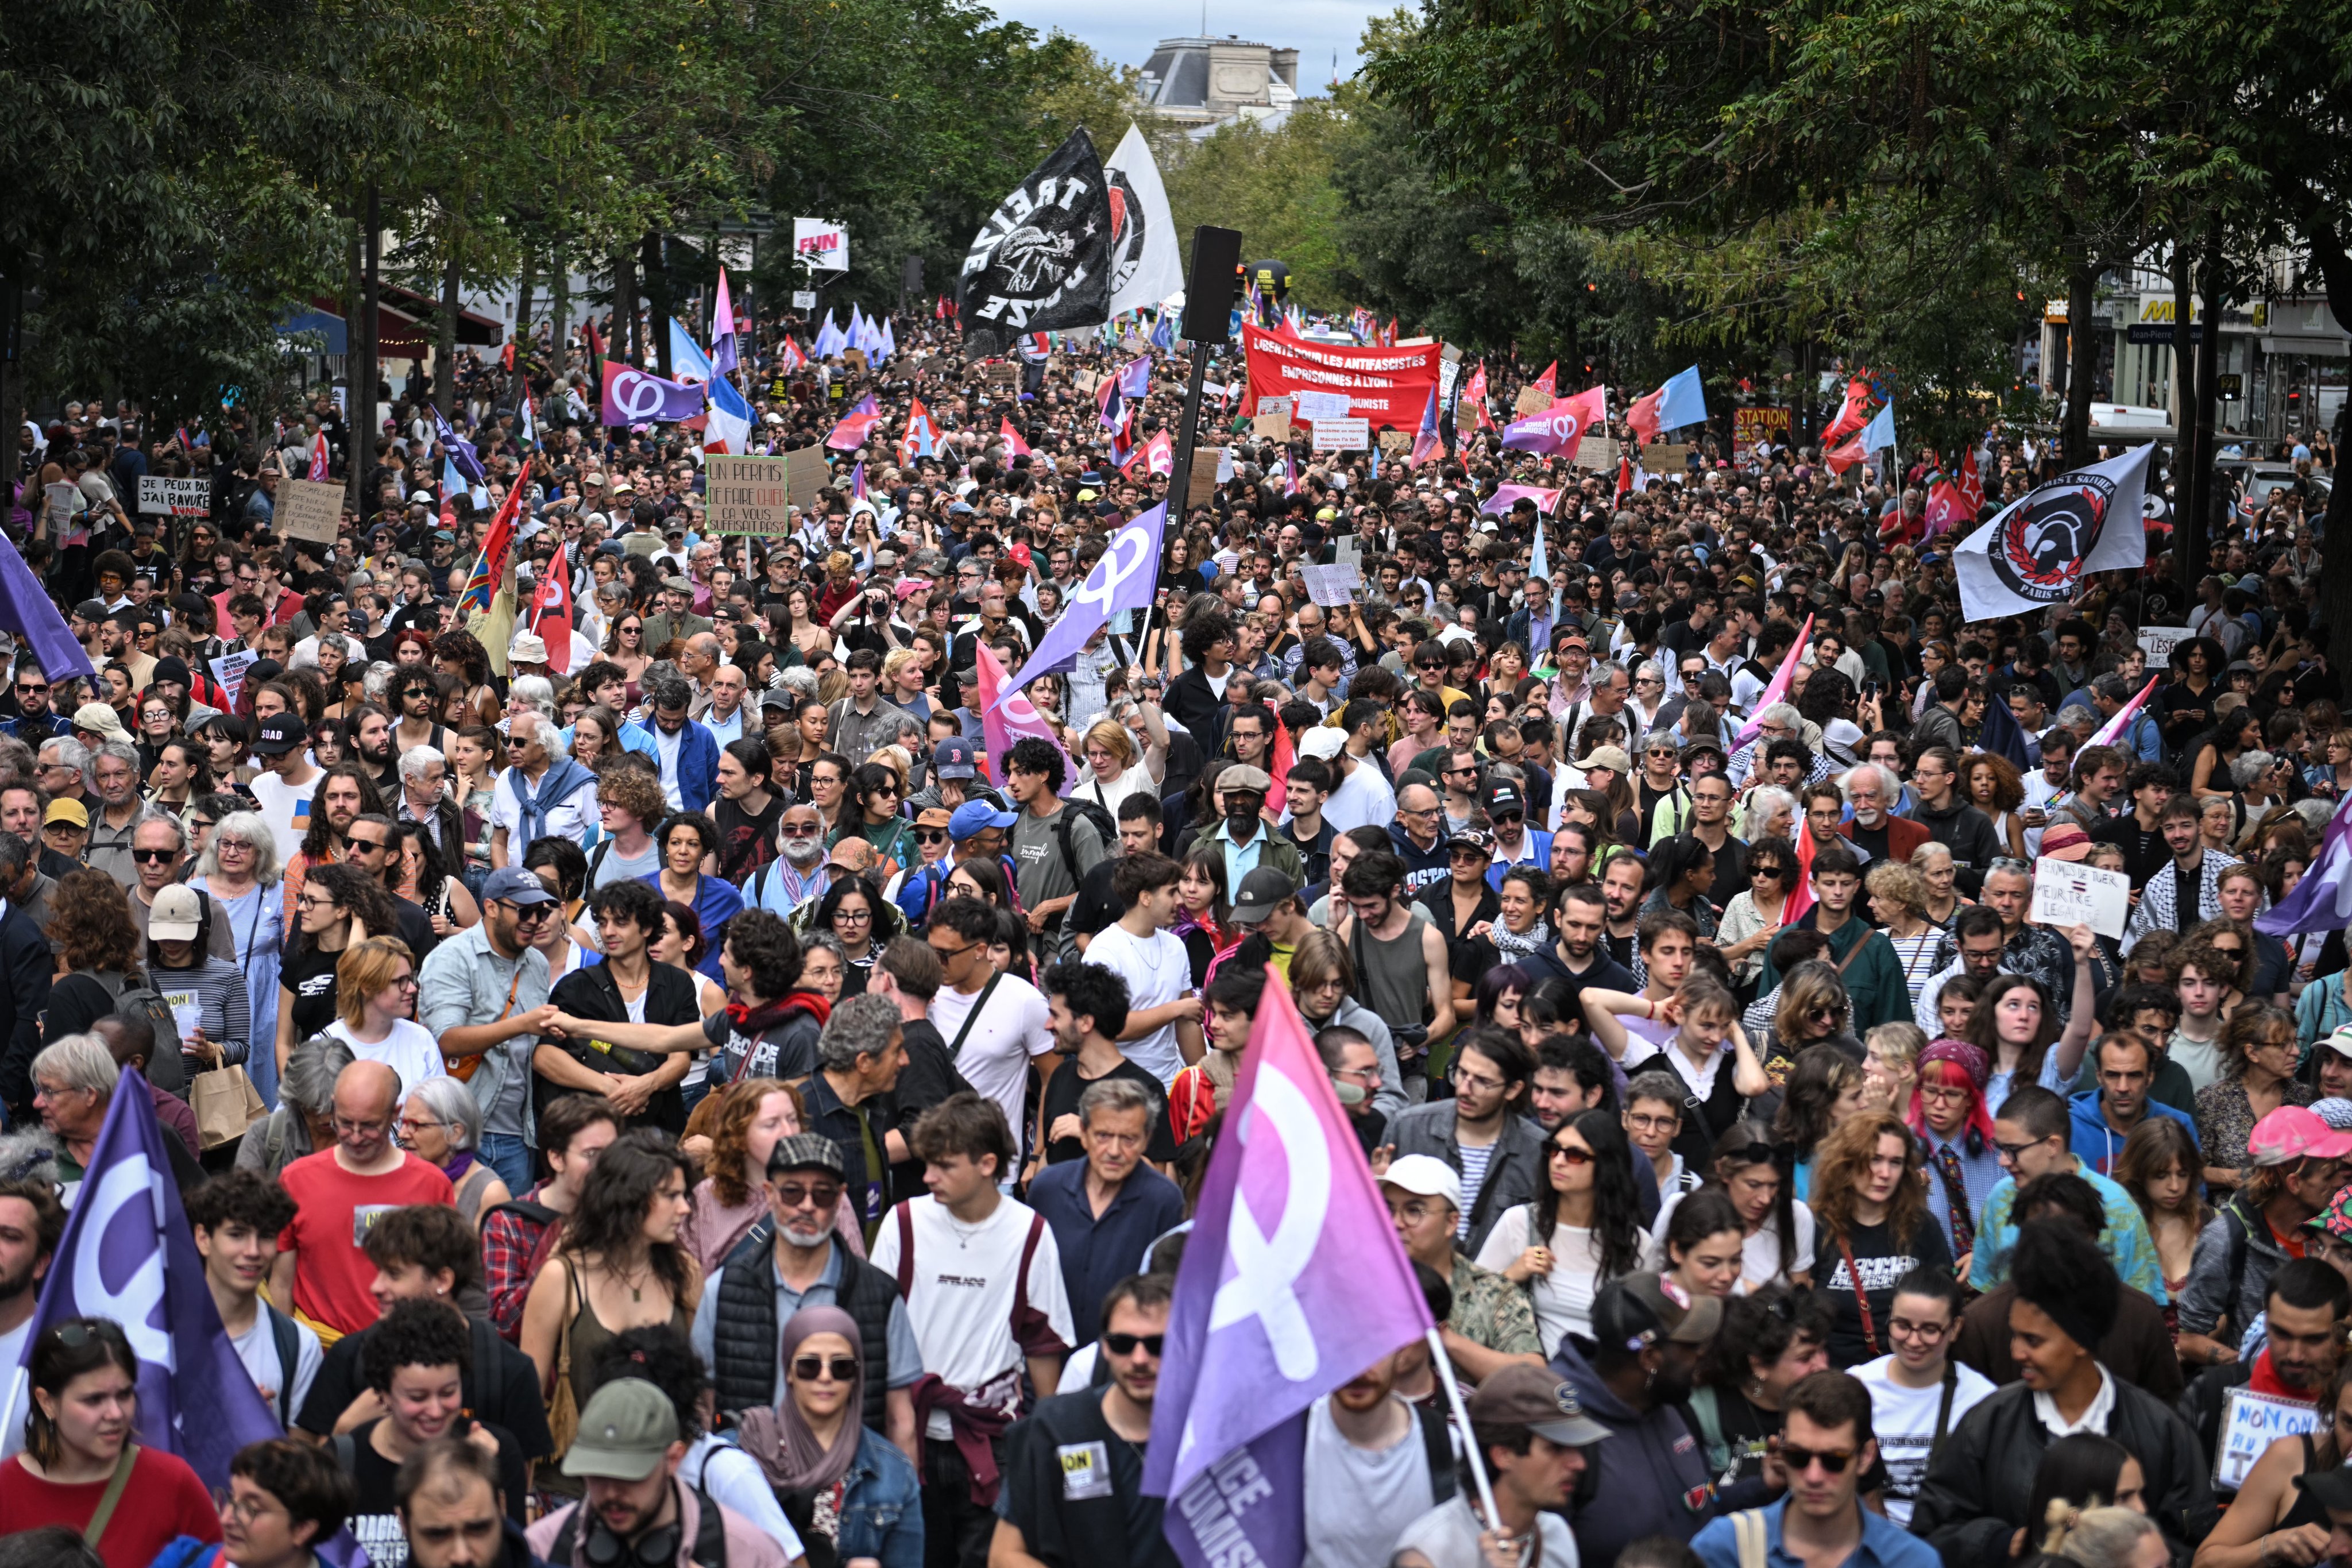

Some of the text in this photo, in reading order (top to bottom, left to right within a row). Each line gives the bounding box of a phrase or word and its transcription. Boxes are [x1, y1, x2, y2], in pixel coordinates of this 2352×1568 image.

[800, 233, 838, 253] FUN
[2132, 330, 2172, 339] Jean-Pierre
[1253, 337, 1426, 371] LIBERTÉ POUR LES ANTIFASCISTES
[1362, 377, 1387, 388] LYON
[1737, 410, 1787, 424] STATION
[709, 462, 782, 482] UN PERMIS
[142, 480, 210, 493] JE PEUX PAS
[298, 485, 342, 499] COMPLIQUÉ
[168, 493, 210, 509] BAVURE
[709, 486, 786, 506] DE FAIRE CHIER
[742, 508, 771, 520] VOUS
[300, 520, 322, 531] TUER
[710, 519, 757, 532] SUFFISAIT
[2019, 585, 2052, 599] PARIS
[230, 659, 250, 669] POLICIER
[233, 667, 245, 675] VOUS
[1100, 663, 1114, 672] NON
[261, 729, 283, 740] SOAD
[951, 749, 961, 763] B
[1019, 843, 1049, 864] enough
[2038, 859, 2119, 888] PERMIS DE TUER
[2035, 884, 2093, 907] MEURTRE
[2237, 1404, 2281, 1432] NON
